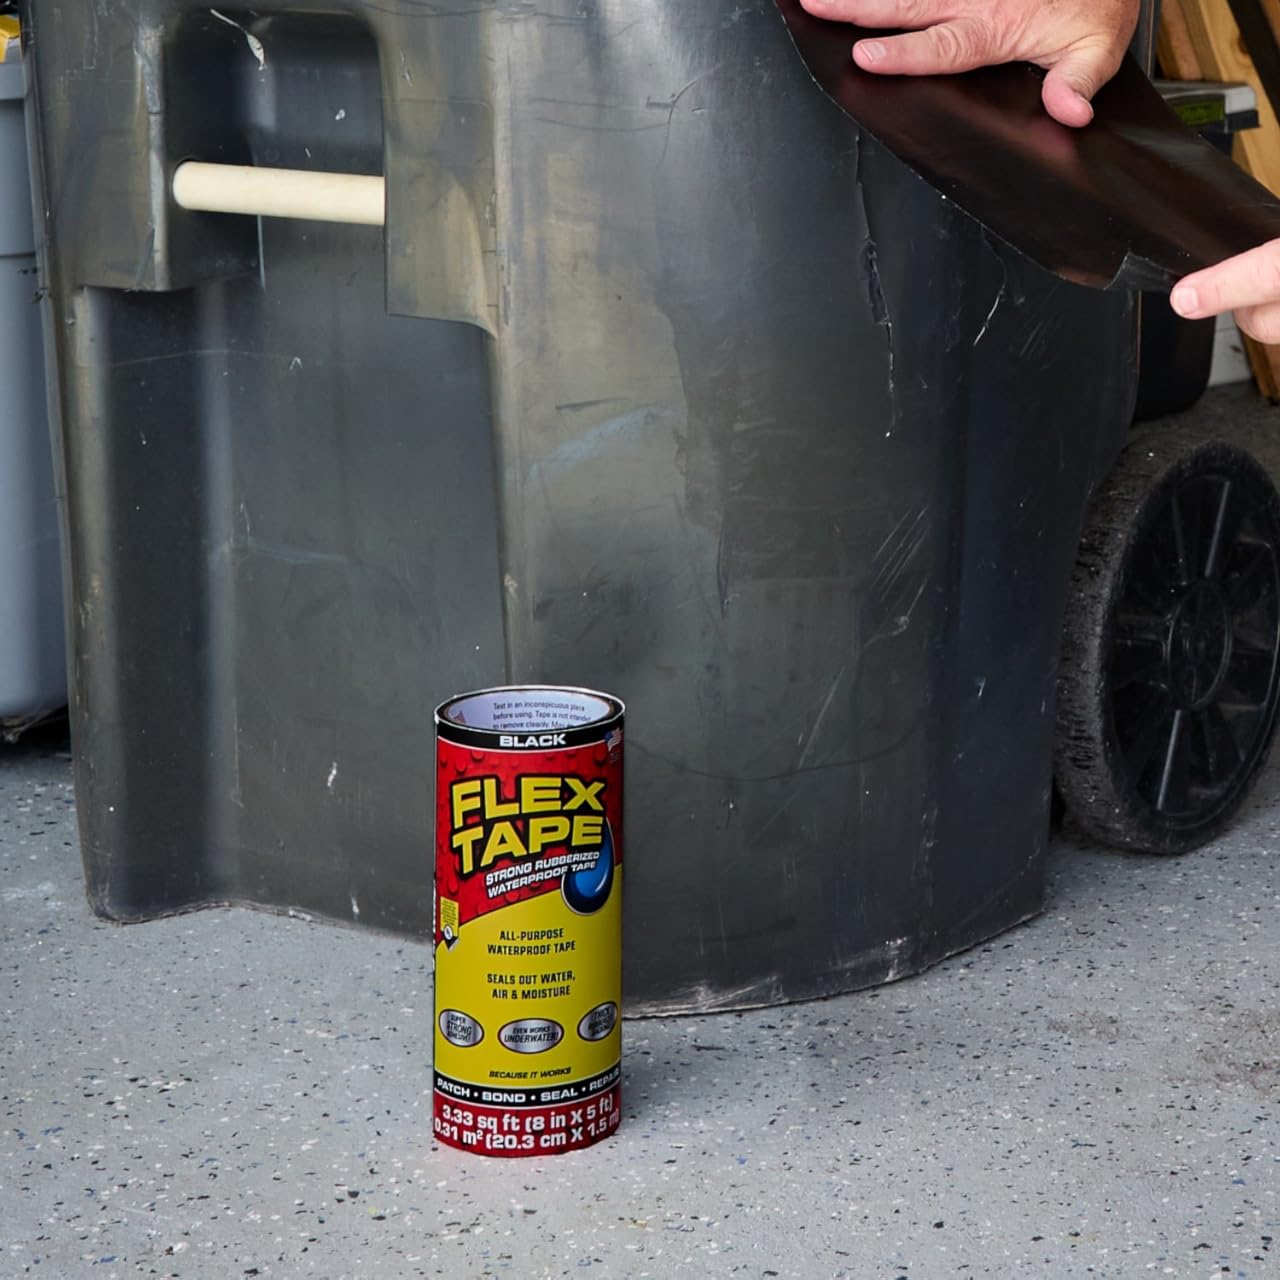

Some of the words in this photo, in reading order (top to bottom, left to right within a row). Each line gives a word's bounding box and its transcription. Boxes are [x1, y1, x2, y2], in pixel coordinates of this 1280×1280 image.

[499, 733, 567, 748] BLACK
[451, 776, 606, 830] FLEX
[451, 815, 604, 875] TAPE
[486, 861, 533, 886] STRONG
[534, 851, 600, 871] RUBBERIZED
[487, 865, 569, 899] WATERPROOF
[571, 860, 597, 873] TAPE
[499, 927, 565, 942] ALL-PURPOSE
[487, 943, 552, 956] WATERPROOF
[553, 940, 577, 954] TAPE
[487, 973, 516, 985] SEALS
[518, 974, 538, 985] OUT
[540, 970, 576, 984] WATER,
[491, 988, 508, 1000] AIR
[511, 989, 518, 1000] &
[521, 985, 571, 1000] MOISTURE
[489, 1070, 528, 1079] BECAUSE
[437, 1077, 470, 1098] PATCH
[481, 1091, 526, 1103] BOND
[540, 1087, 578, 1102] SEAL
[442, 1104, 473, 1126] 3.33
[477, 1115, 498, 1134] sq
[502, 1113, 520, 1132] ft
[525, 1115, 545, 1133] (8
[550, 1111, 566, 1129] in
[570, 1109, 583, 1126] X
[586, 1104, 596, 1120] 5
[599, 1093, 613, 1115] ft)
[434, 1117, 458, 1141] 0.31
[485, 1133, 535, 1150] (20.3
[540, 1132, 567, 1147] cm
[571, 1127, 583, 1143] X
[587, 1117, 607, 1137] 1.5
